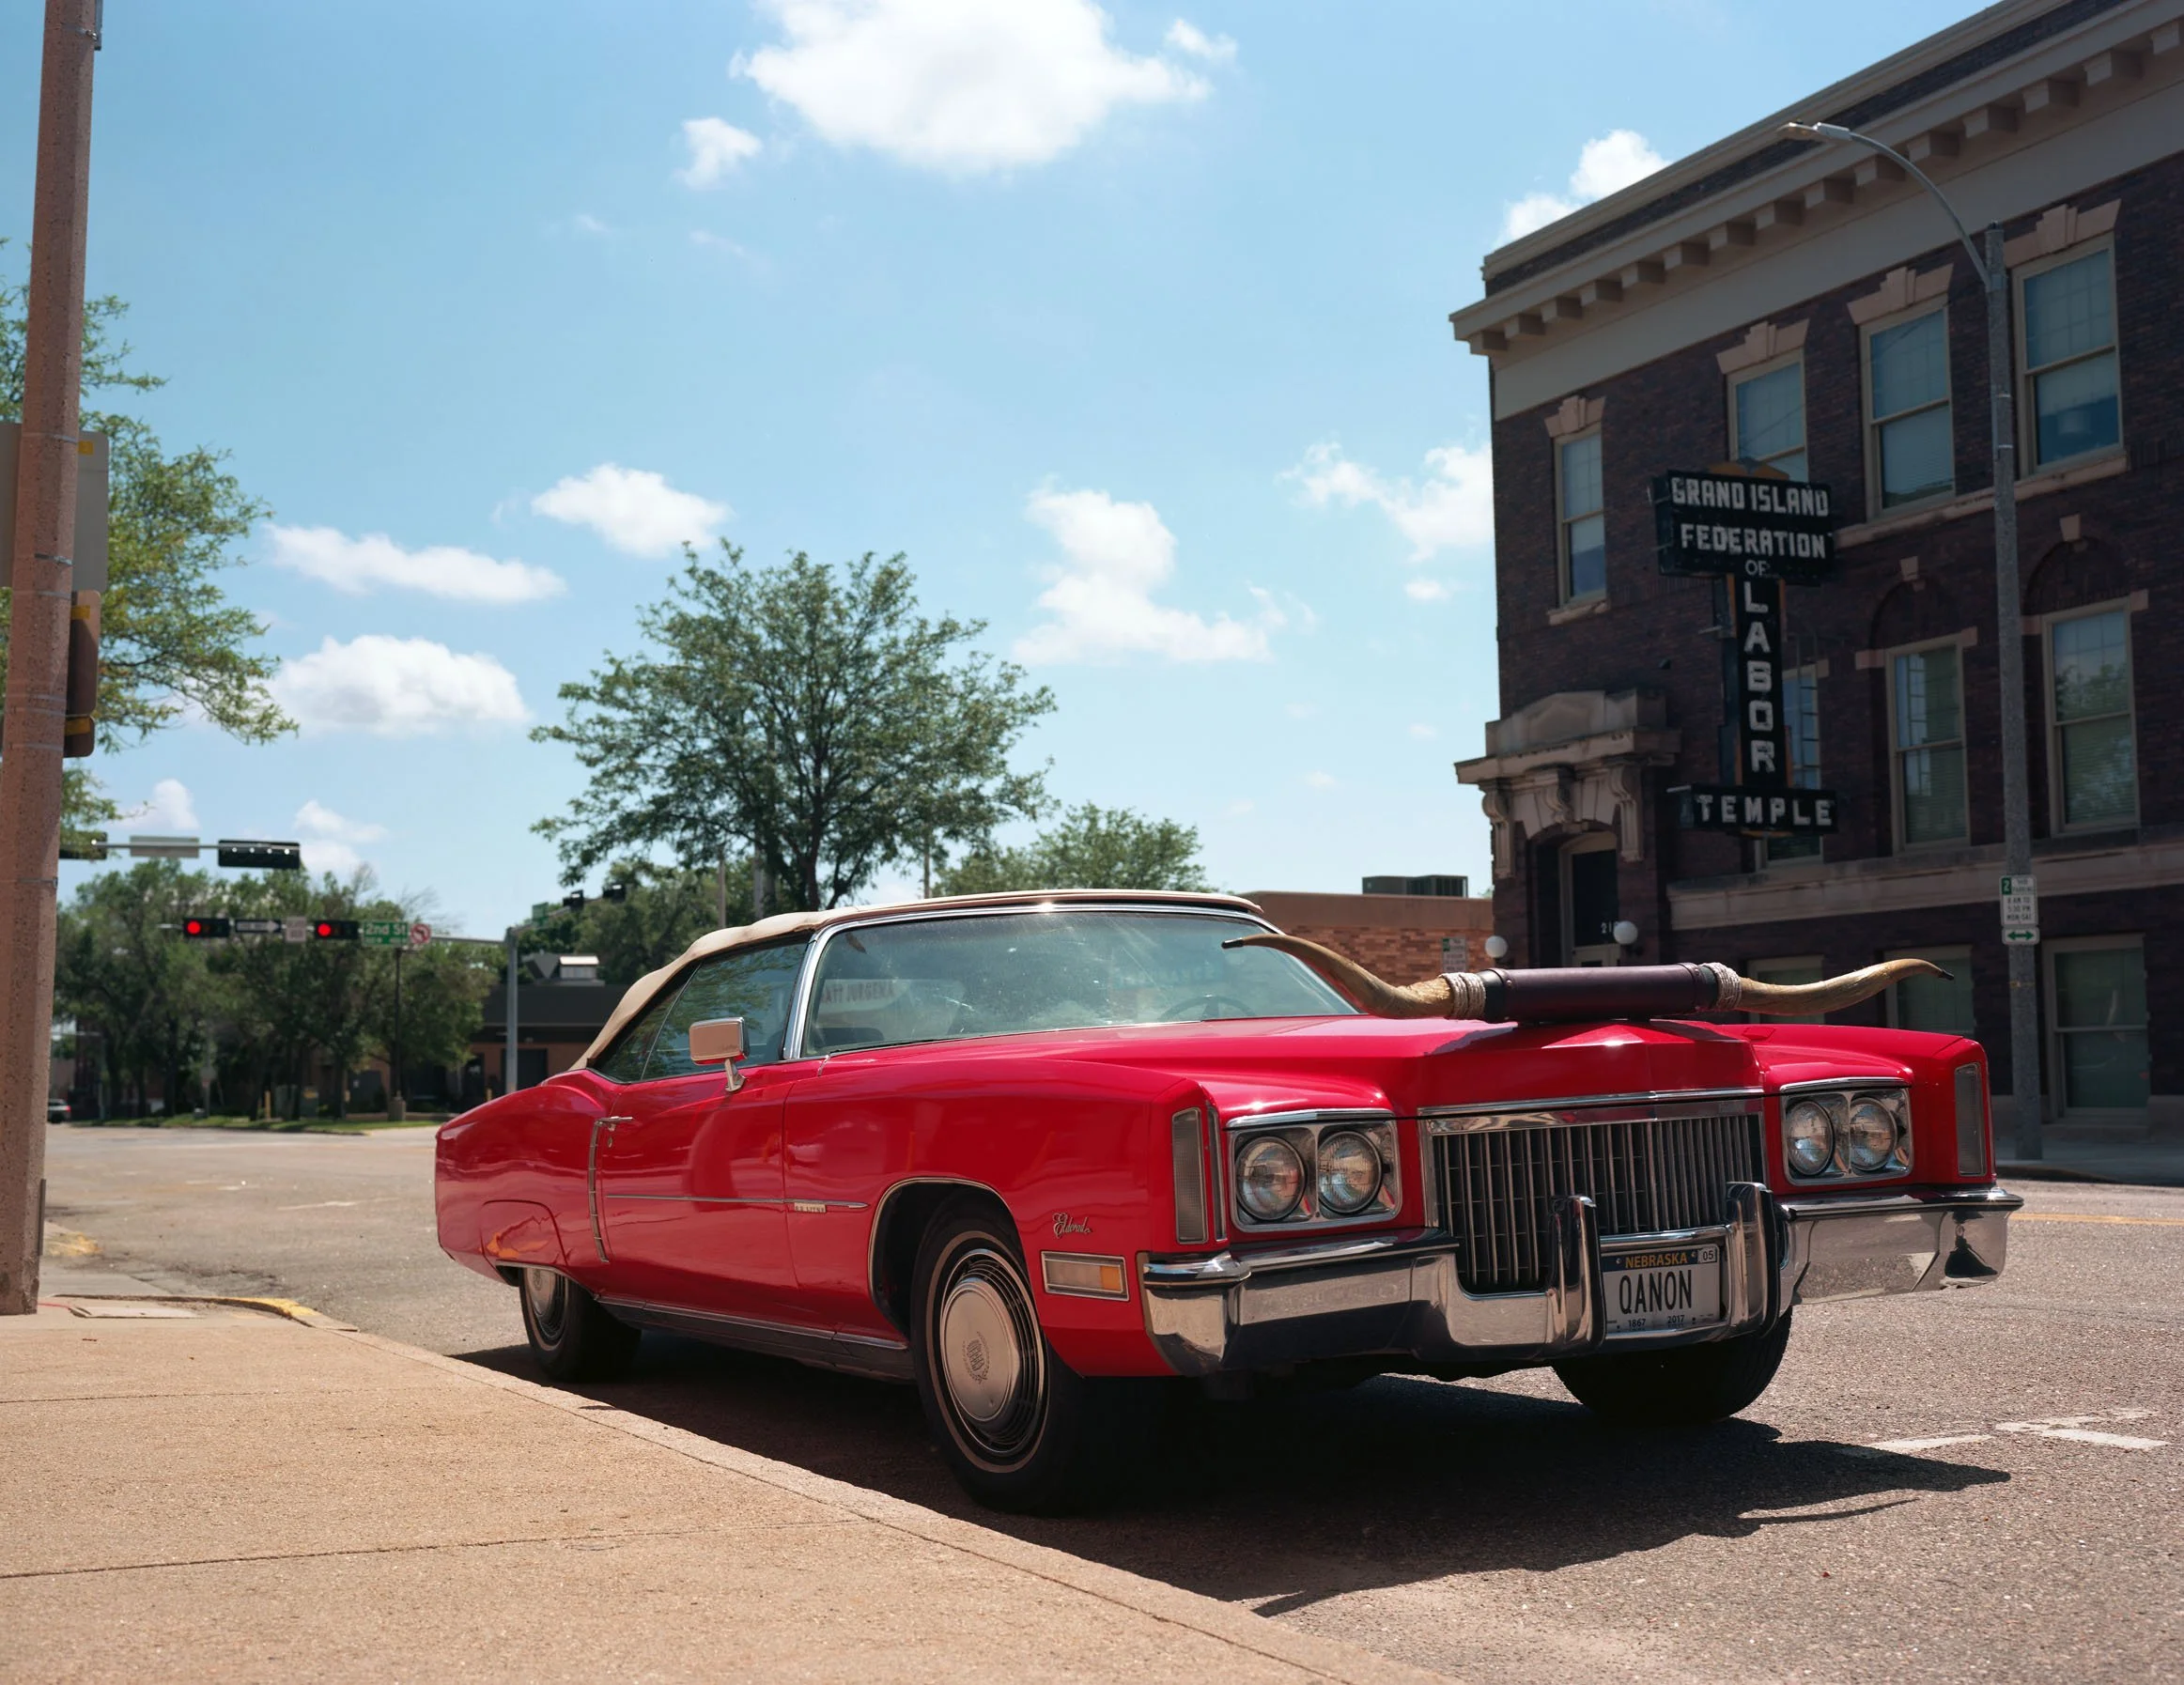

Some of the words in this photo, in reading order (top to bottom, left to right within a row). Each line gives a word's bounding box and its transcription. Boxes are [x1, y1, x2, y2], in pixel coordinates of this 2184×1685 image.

[1671, 476, 1745, 509] GRAND
[1750, 484, 1829, 517] ISLAND
[1681, 523, 1826, 559] FEDERATION
[1745, 560, 1767, 576] OF
[1743, 581, 1775, 773] LABOR
[1696, 793, 1833, 826] TEMPLE
[2003, 879, 2010, 892] 2
[366, 923, 390, 935] 2nd
[393, 922, 406, 935] St
[1053, 1213, 1092, 1239] Eldorado
[1625, 1252, 1688, 1269] NEBRASKA
[1702, 1250, 1714, 1260] 05
[1619, 1270, 1692, 1315] QANON
[1628, 1318, 1647, 1327] 1867
[1667, 1315, 1685, 1324] 2017
